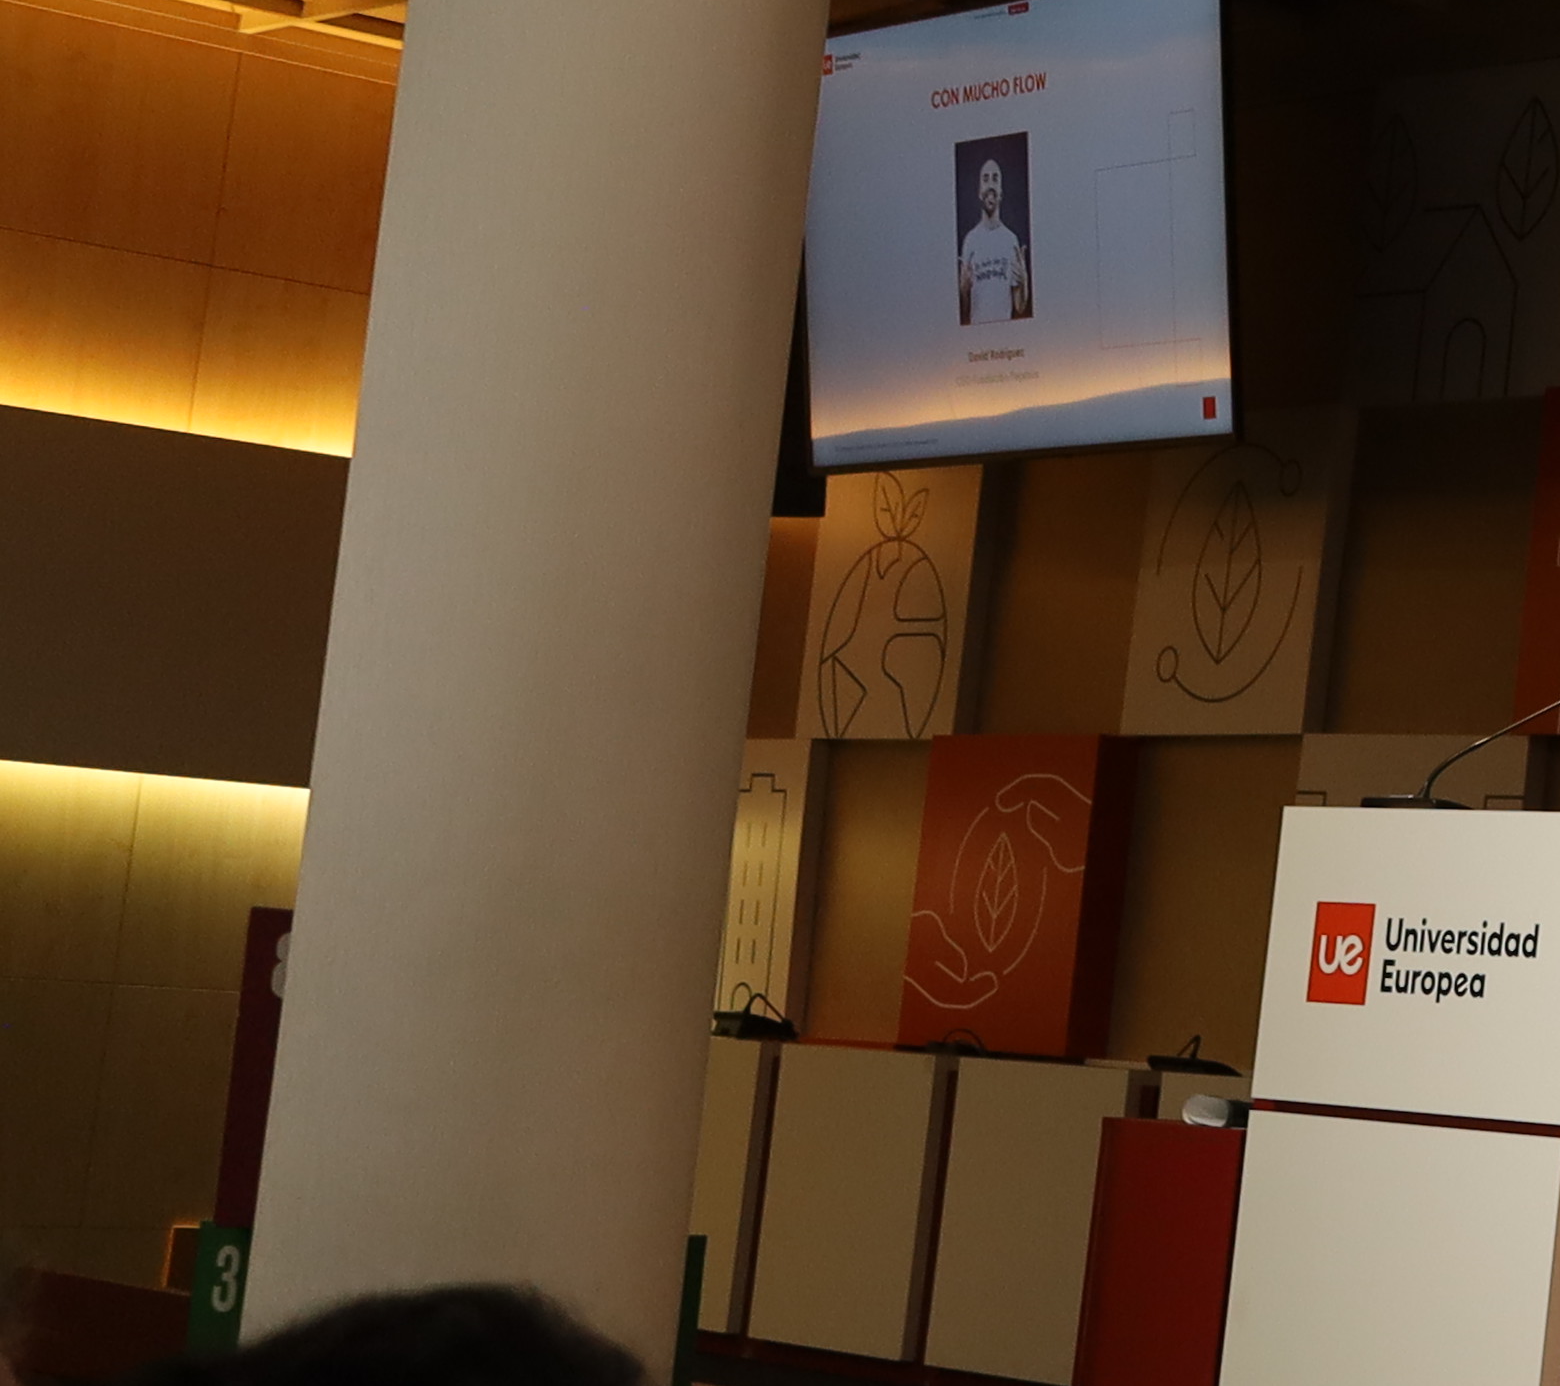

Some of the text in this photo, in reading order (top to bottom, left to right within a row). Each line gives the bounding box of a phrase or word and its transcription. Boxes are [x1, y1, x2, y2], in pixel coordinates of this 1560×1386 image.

[931, 72, 1047, 109] CON MUCHO FLOW
[1318, 934, 1364, 975] ue
[1385, 917, 1540, 958] Universidad
[1380, 959, 1486, 1003] Europea
[212, 1245, 241, 1313] 3
